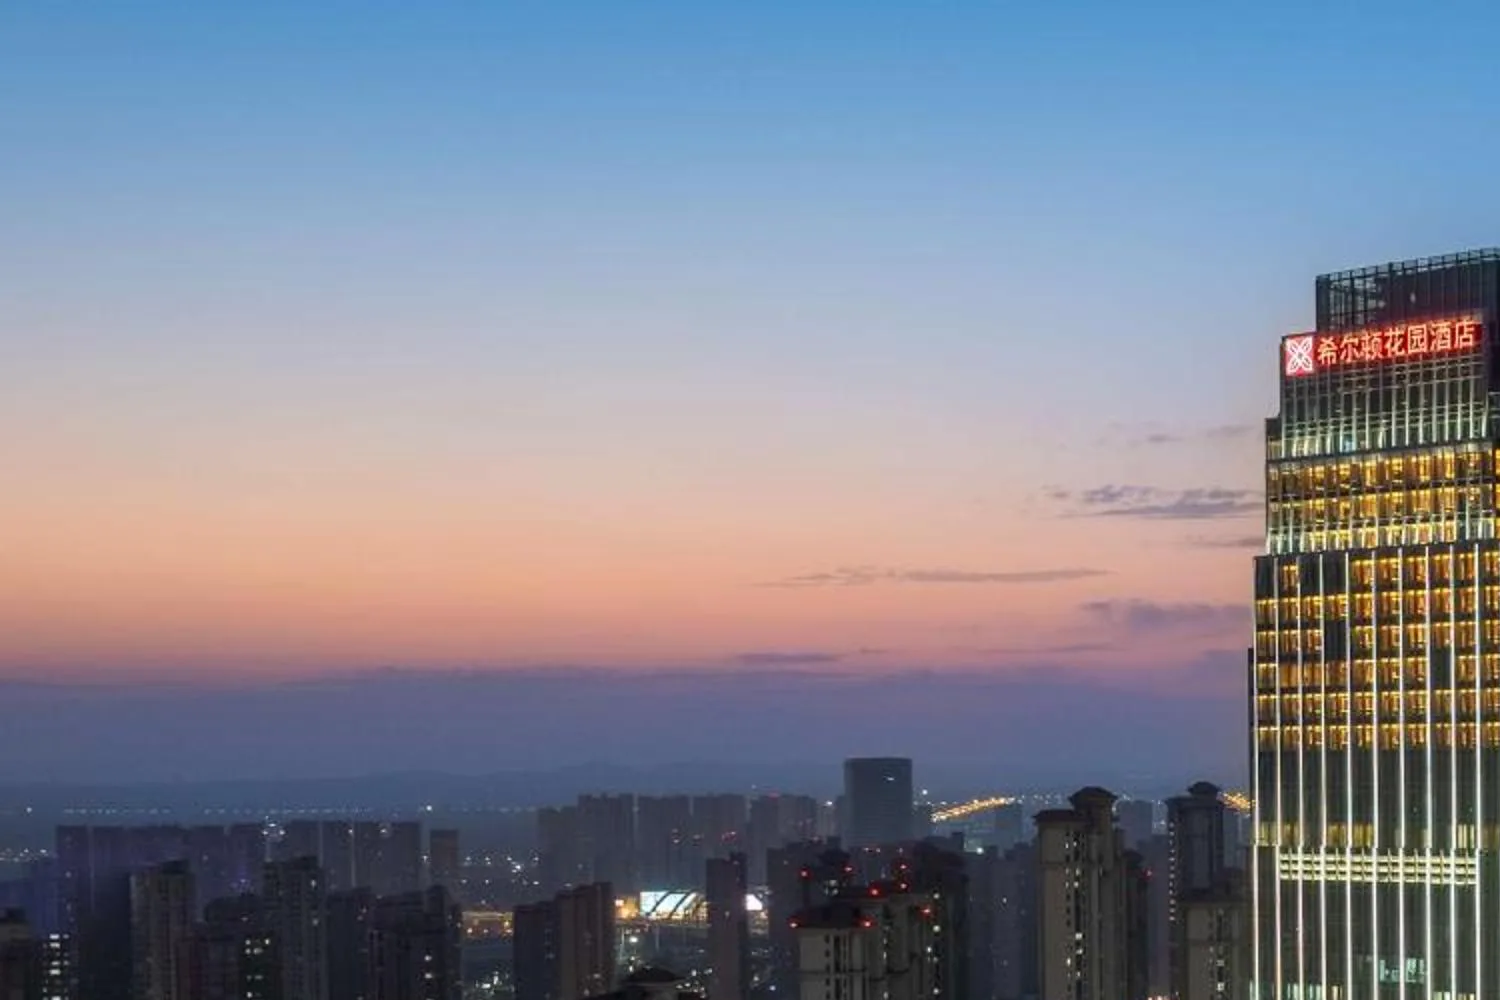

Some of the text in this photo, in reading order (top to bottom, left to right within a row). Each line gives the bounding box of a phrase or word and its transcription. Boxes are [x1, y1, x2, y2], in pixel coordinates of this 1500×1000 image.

[1316, 320, 1475, 366] 希尔顿花园酒店
